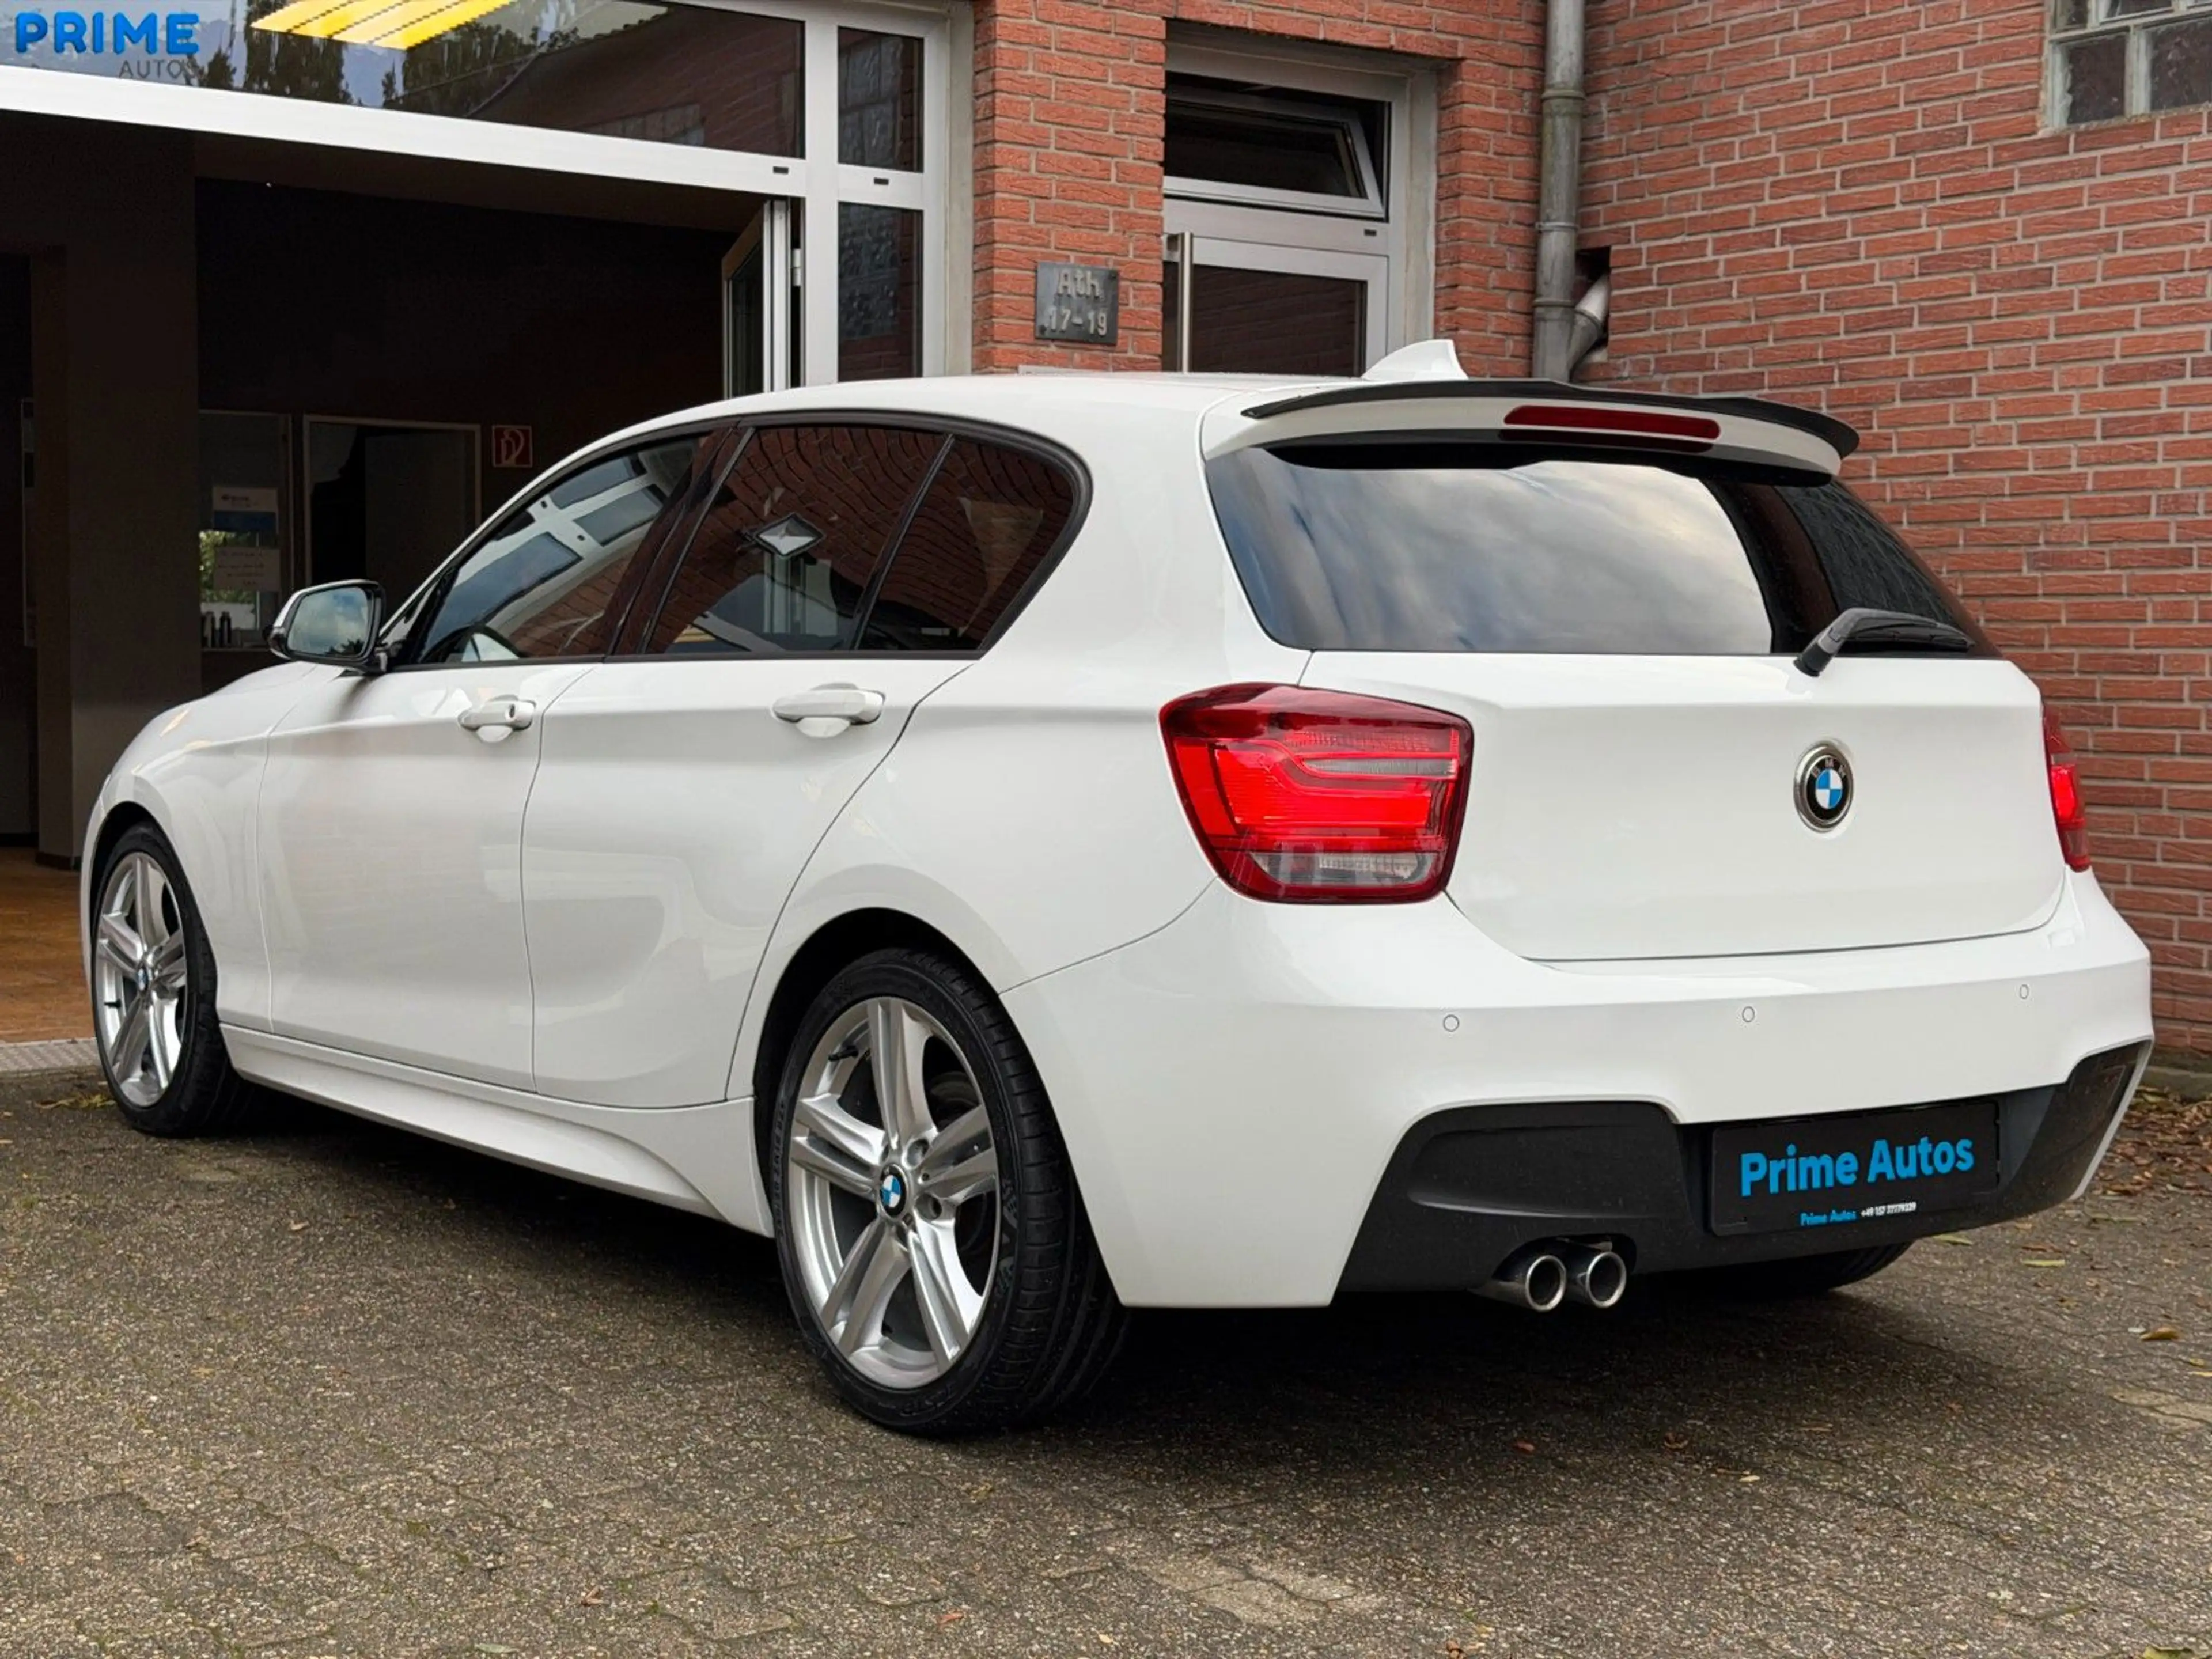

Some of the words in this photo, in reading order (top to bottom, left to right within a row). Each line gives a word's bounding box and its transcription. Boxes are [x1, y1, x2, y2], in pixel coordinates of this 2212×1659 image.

[1810, 756, 1847, 778] BMW
[1740, 1143, 1858, 1197] Prime
[1868, 1136, 1975, 1183] Autos
[1800, 1213, 1828, 1226] Prime
